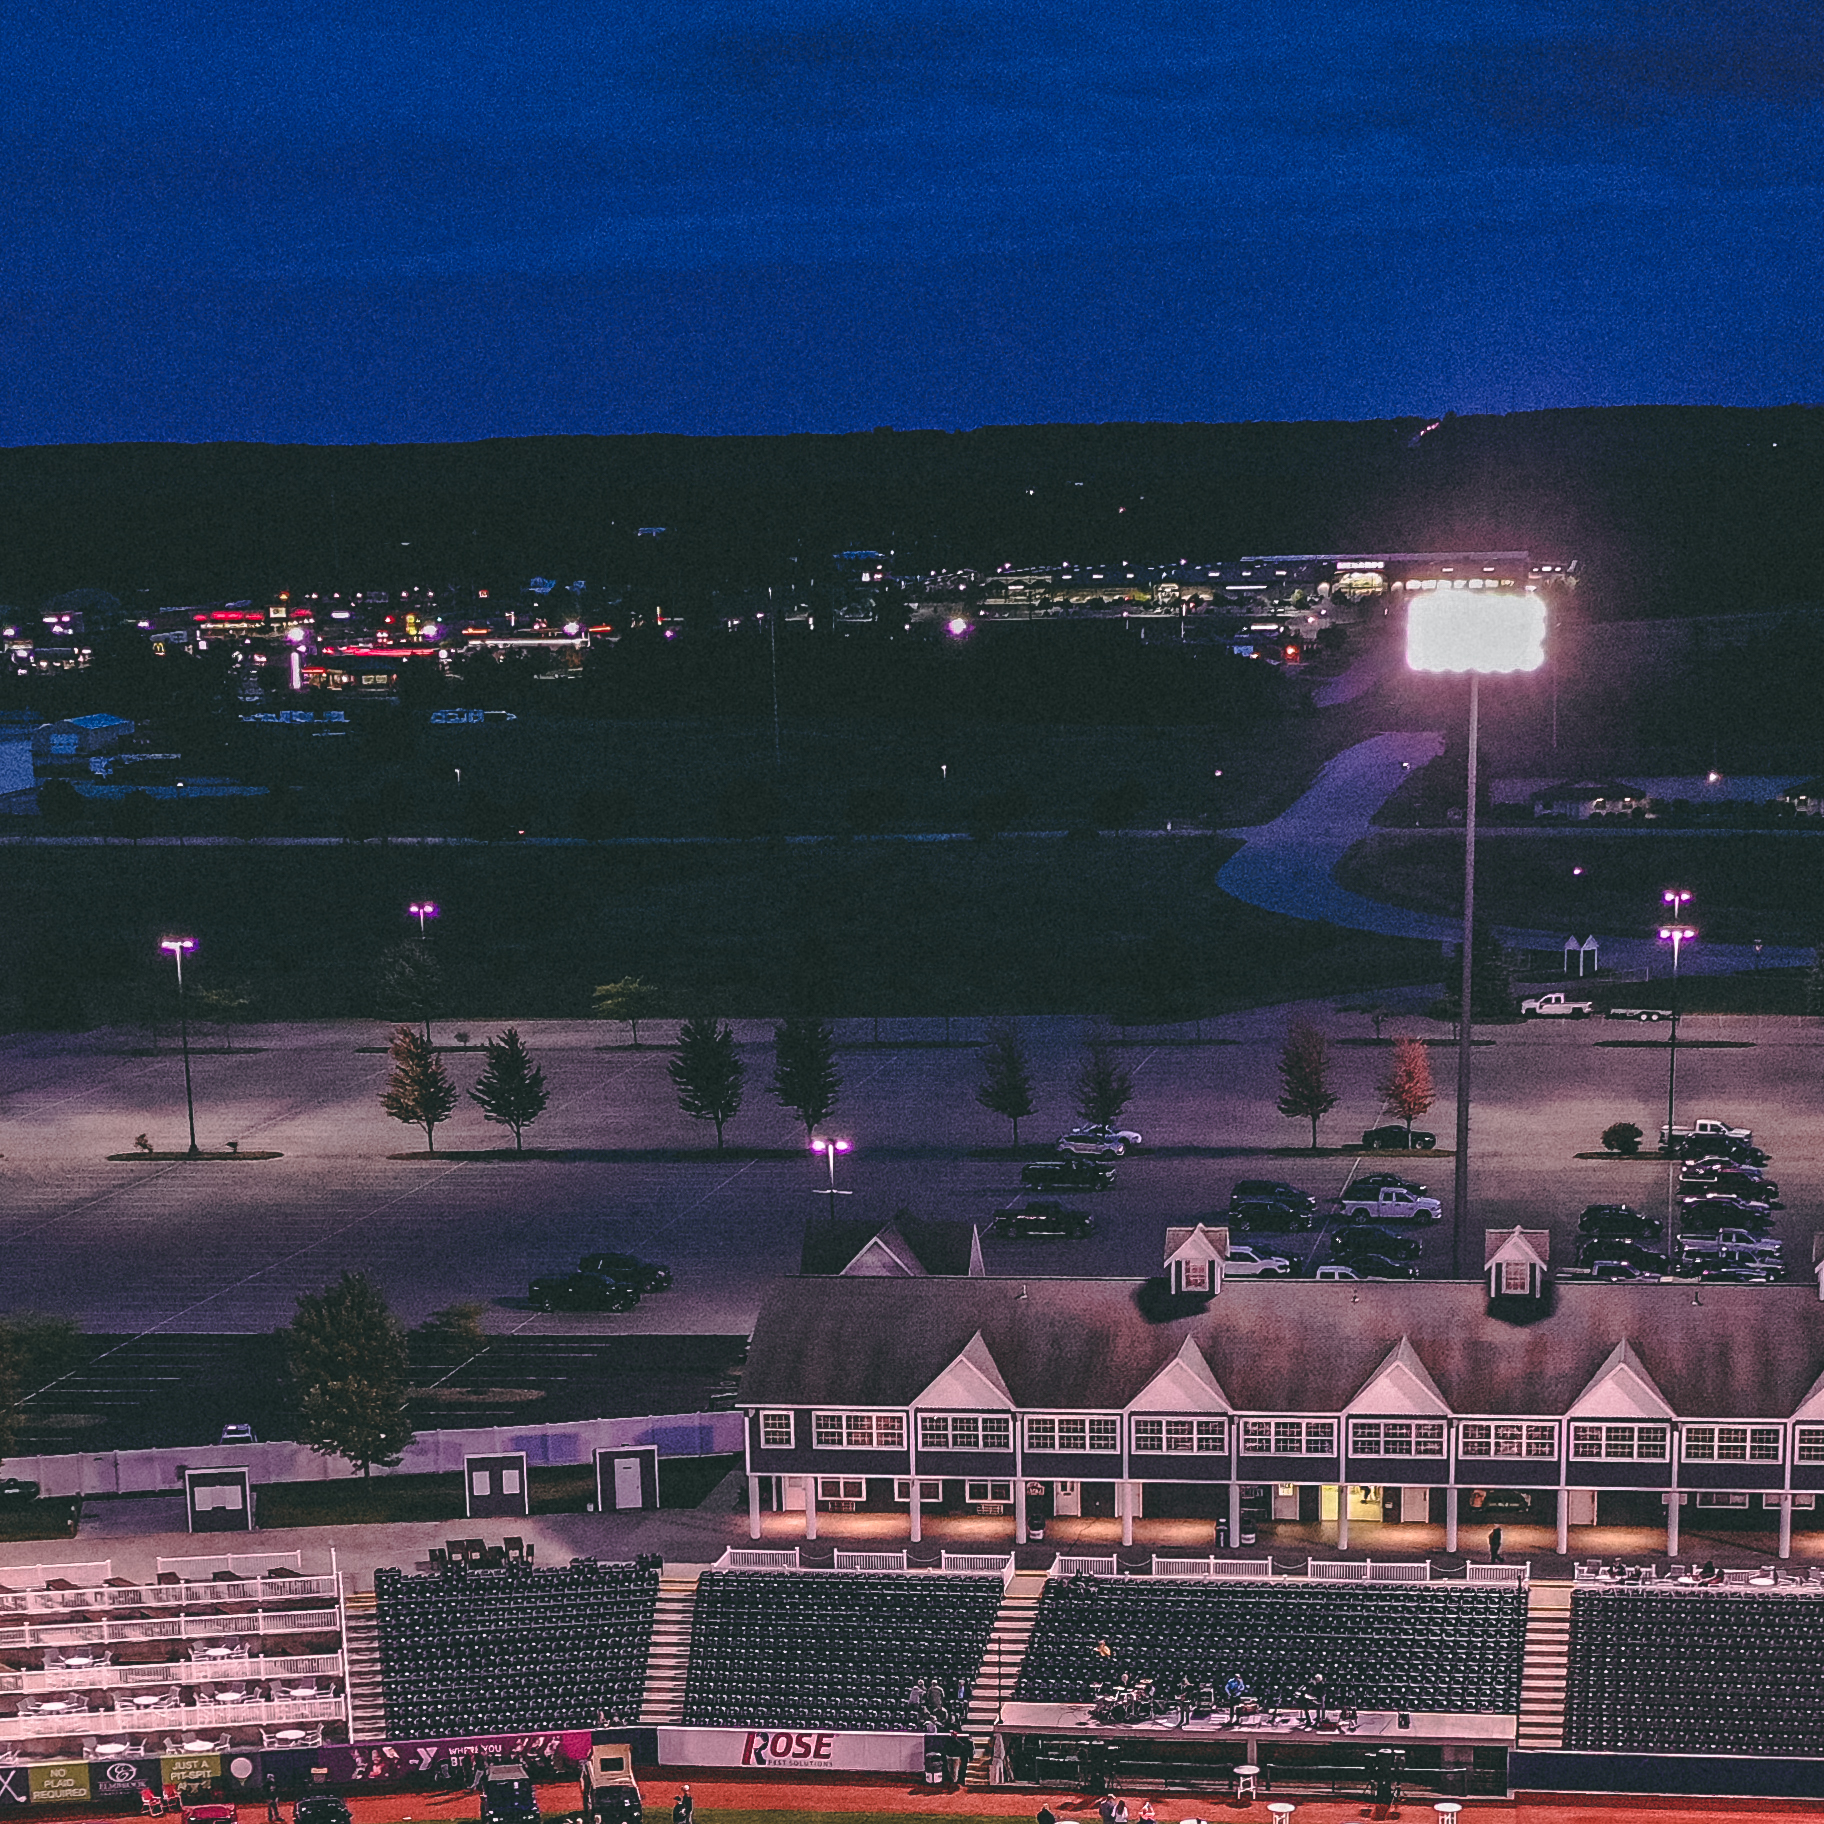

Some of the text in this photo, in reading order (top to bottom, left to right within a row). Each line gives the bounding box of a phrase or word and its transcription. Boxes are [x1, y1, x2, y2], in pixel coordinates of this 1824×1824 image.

[480, 1744, 502, 1753] YOU
[741, 1731, 837, 1766] ROSE
[172, 1760, 210, 1771] JUST A
[788, 1760, 833, 1768] SOLUTIONS
[50, 1768, 67, 1778] NO
[170, 1769, 212, 1781] PIT-SPIT
[43, 1779, 76, 1788] PLAID
[33, 1788, 89, 1800] REQUIRED
